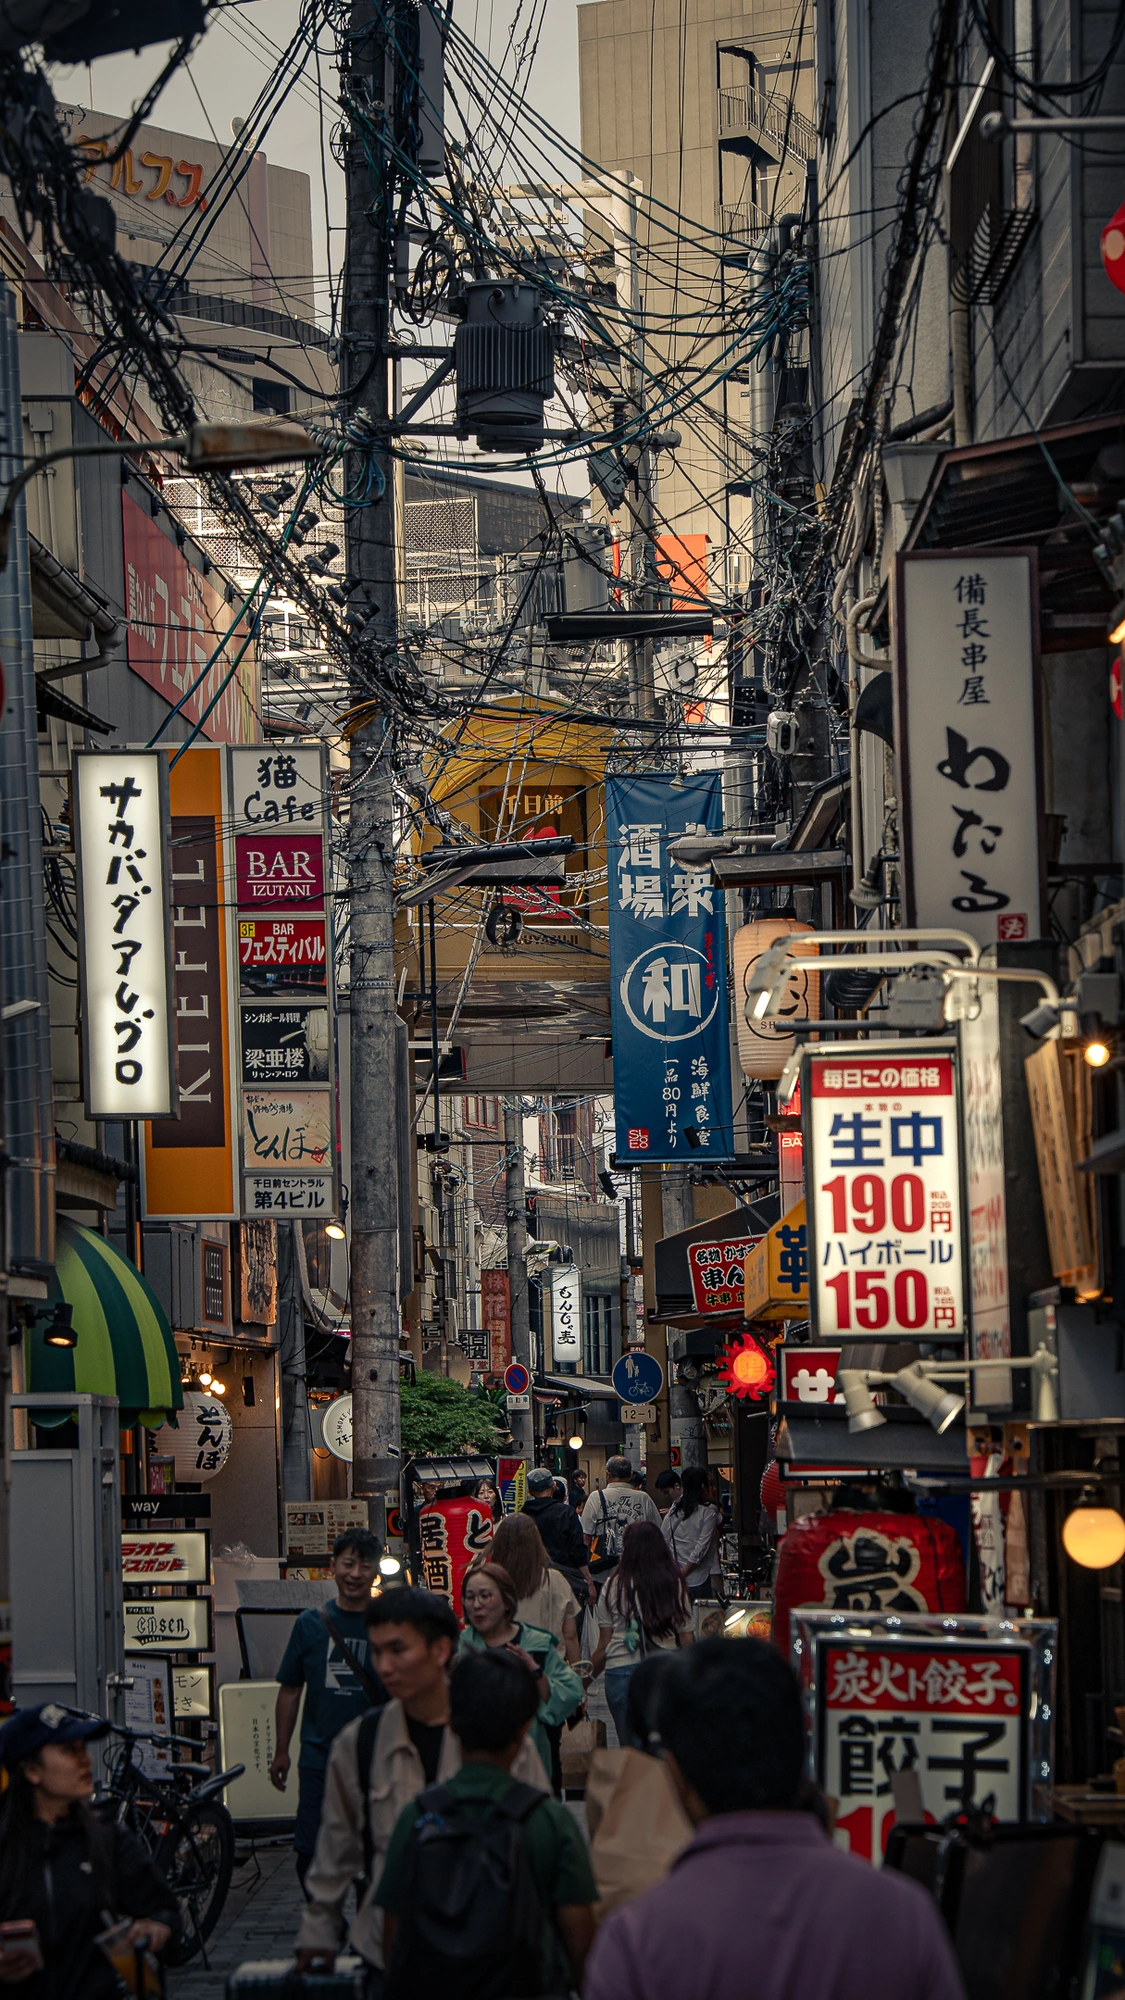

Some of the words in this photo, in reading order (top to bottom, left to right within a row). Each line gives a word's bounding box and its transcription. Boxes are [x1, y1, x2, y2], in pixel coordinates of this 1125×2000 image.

[76, 135, 208, 212] アルプス
[954, 573, 991, 706] 備長串屋
[257, 755, 297, 789] 猫
[244, 790, 315, 822] Cafe
[506, 794, 564, 815] 千日前
[937, 725, 1012, 913] わたる
[247, 851, 315, 878] BAR
[618, 824, 664, 920] 酒場
[668, 822, 714, 917] 衆
[252, 885, 310, 896] IZUTANI
[241, 923, 254, 936] 3F
[272, 923, 295, 936] BAR
[240, 935, 326, 963] フェスティバル
[172, 859, 211, 1103] KIEFEL
[642, 956, 702, 1023] 和
[244, 1012, 301, 1024] シンガポール料理
[245, 1048, 305, 1069] 梁亜楼
[823, 1067, 941, 1090] 毎日この価格
[662, 1058, 681, 1149] 一品80円より
[690, 1055, 711, 1146] 海鮮食堂
[247, 1109, 314, 1161] とんぼ
[829, 1111, 944, 1168] 生中
[253, 1178, 325, 1189] 千日前セントラル
[254, 1191, 325, 1209] 第4ビル
[821, 1173, 926, 1234] 190
[930, 1211, 952, 1232] 円
[696, 1247, 722, 1265] 名物
[823, 1239, 953, 1266] ハイボール
[825, 1269, 929, 1330] 150
[933, 1306, 956, 1329] 円
[196, 1405, 224, 1469] とんぼ
[337, 1412, 348, 1434] SMOKE
[131, 1502, 160, 1514] way
[122, 1558, 183, 1573] スポット
[838, 1715, 1010, 1803] 餃子
